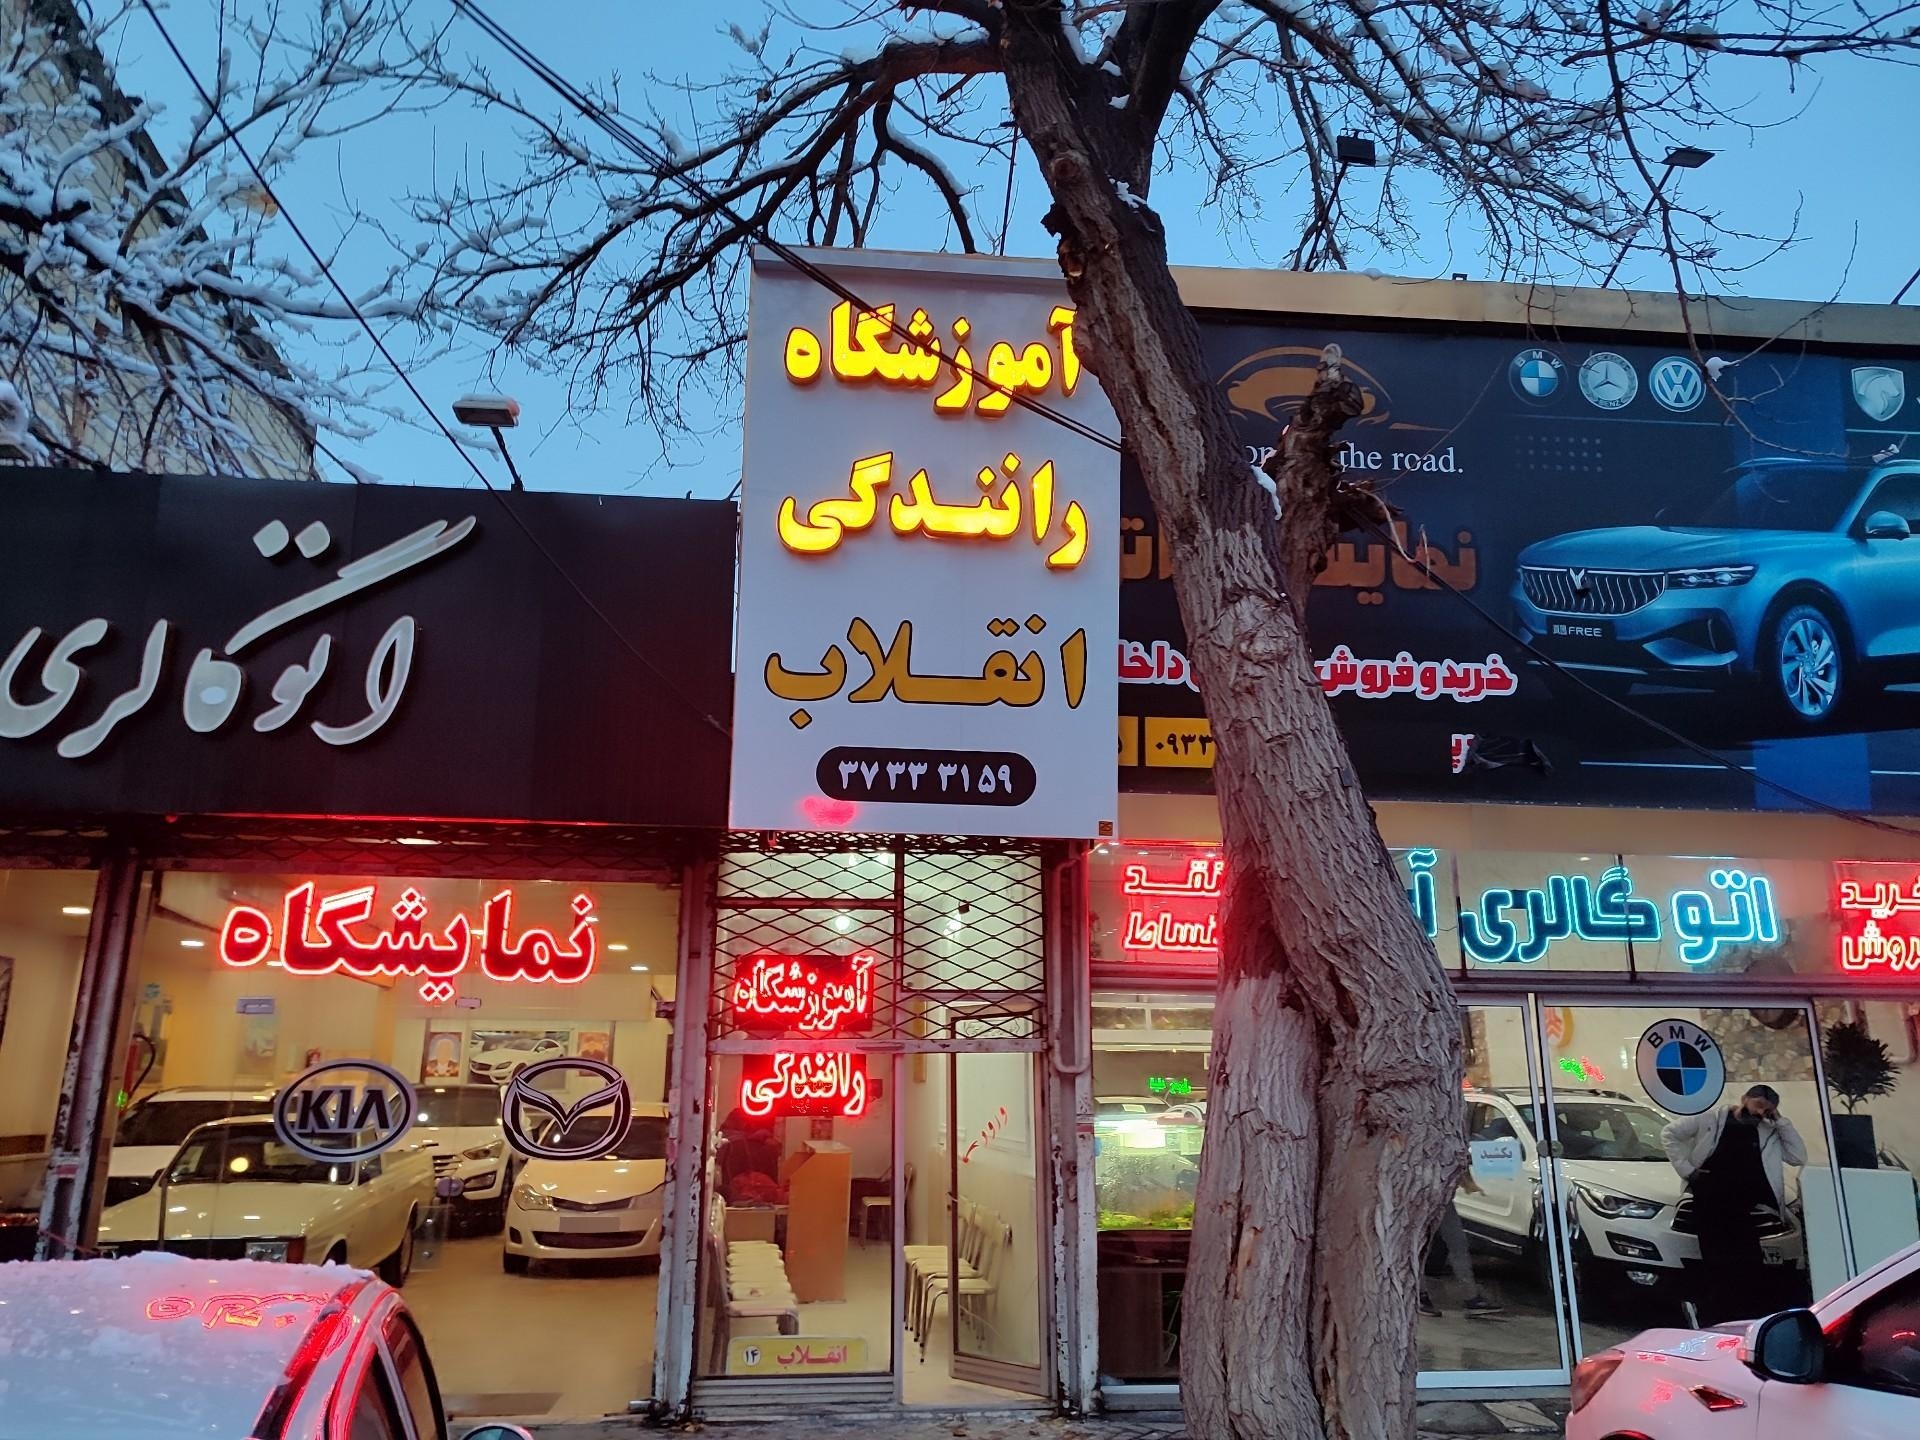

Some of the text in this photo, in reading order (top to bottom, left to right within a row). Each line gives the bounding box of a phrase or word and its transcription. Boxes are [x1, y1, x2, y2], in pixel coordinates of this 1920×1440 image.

[784, 299, 1081, 414] آموزشگاه
[1338, 442, 1383, 471] the
[1391, 447, 1464, 474] road.
[777, 452, 1090, 568] رانندگی
[1118, 643, 1184, 681] داخل
[1568, 626, 1603, 638] FREE
[763, 613, 1088, 730] انقلاب
[220, 881, 597, 1002] نمایشگاه
[1461, 866, 1661, 963] گالری
[1672, 869, 1778, 964] اتو
[1841, 919, 1920, 972] روش
[734, 955, 874, 1030] آموزشگاه
[1646, 1025, 1711, 1053] BMW
[297, 1086, 391, 1131] KIA
[776, 1344, 848, 1370] انقلاب
